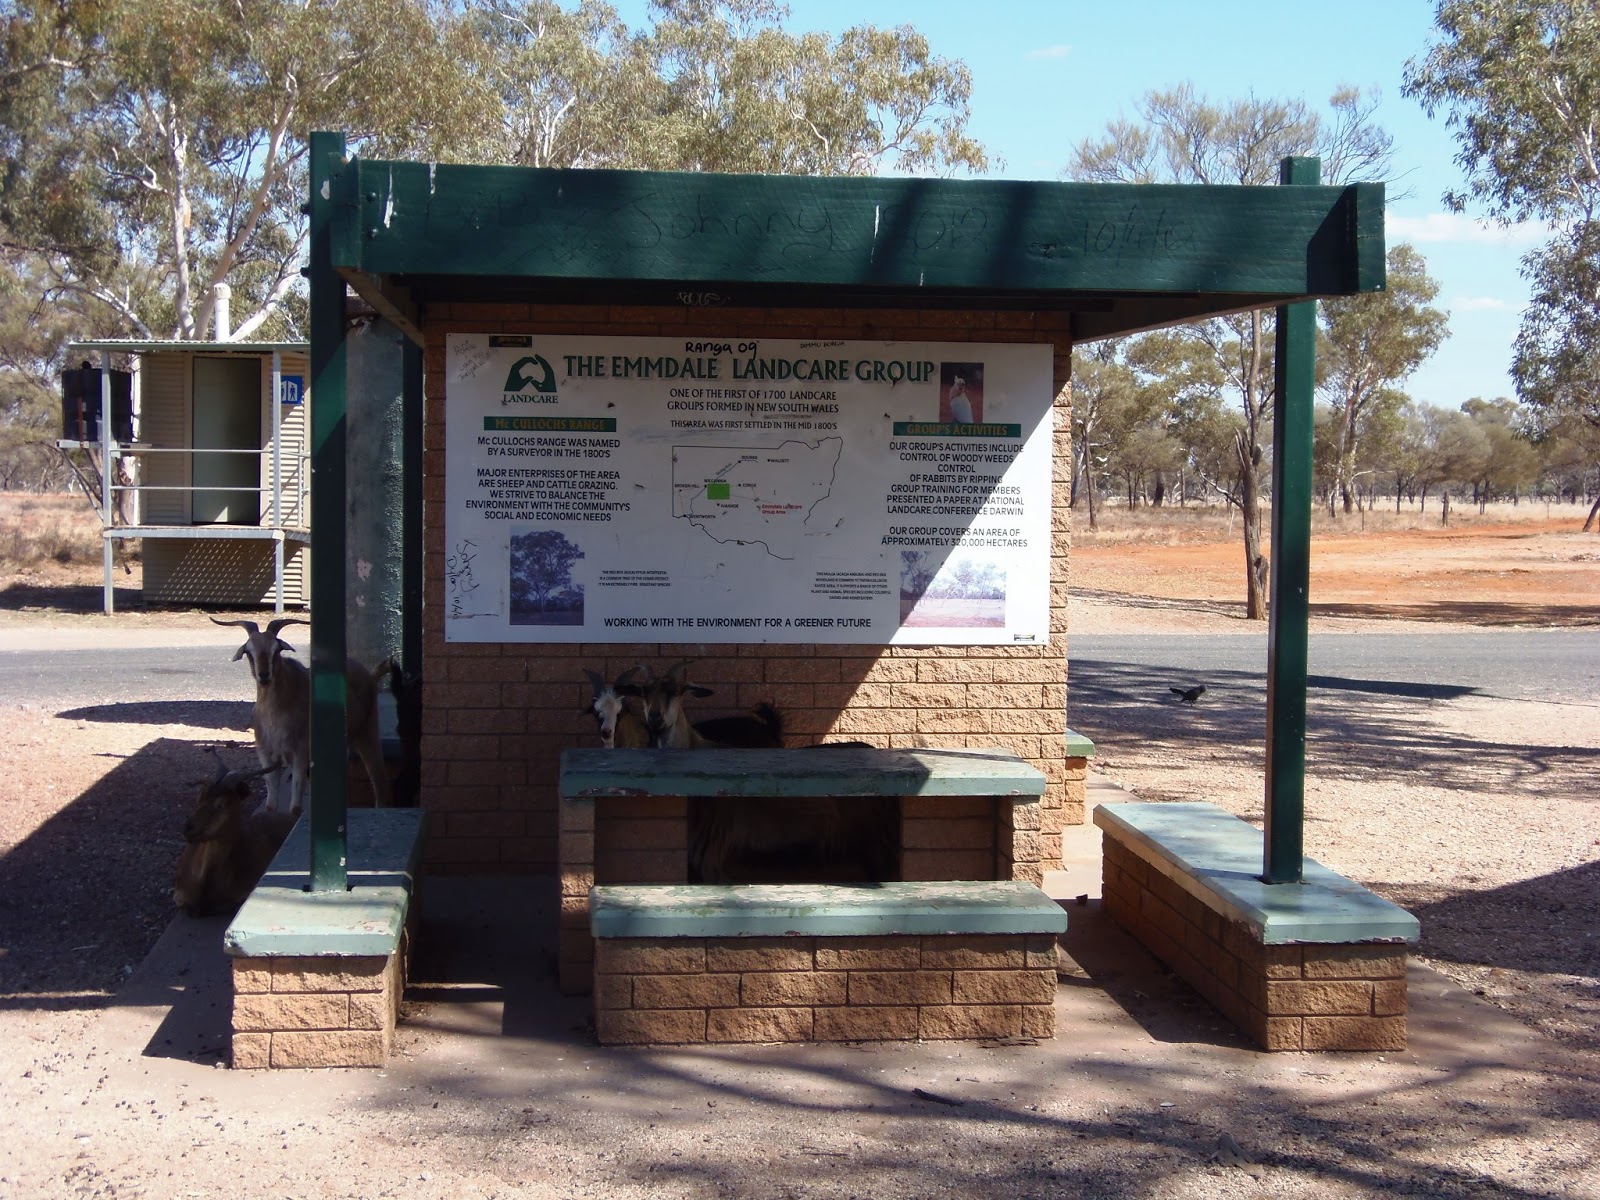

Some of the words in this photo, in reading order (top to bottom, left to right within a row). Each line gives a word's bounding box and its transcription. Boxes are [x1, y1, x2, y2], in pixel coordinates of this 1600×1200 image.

[563, 355, 605, 378] THE
[612, 356, 718, 380] EMMDALE
[732, 358, 850, 382] LANDCARE
[855, 360, 935, 382] GROUP
[503, 394, 558, 404] LANDCARE
[670, 388, 689, 399] ONE
[691, 389, 703, 399] OF
[705, 389, 722, 399] THE
[724, 389, 746, 400] FIRST
[748, 390, 760, 400] OF
[762, 390, 786, 400] 1700
[790, 390, 836, 401] LANDCARE
[667, 400, 704, 411] GROUPS
[706, 401, 742, 412] FORMED
[744, 402, 754, 412] IN
[756, 402, 776, 412] NEW
[778, 402, 808, 413] SOUTH
[810, 403, 838, 413] WALES
[514, 418, 566, 430] CULLOCHS
[571, 419, 606, 430] RANGE
[708, 420, 723, 429] WAS
[724, 421, 742, 429] FIRST
[744, 421, 772, 429] SETTLED
[773, 421, 782, 430] IN
[783, 421, 796, 430] THE
[797, 422, 811, 430] MID
[813, 422, 837, 430] 1800'S
[907, 424, 950, 435] GROUP'S
[951, 425, 1007, 436] ACTIVITIES
[491, 437, 534, 446] CULLOCHS
[536, 438, 566, 447] RANGE
[567, 438, 587, 447] WAS
[588, 438, 620, 448] NAMED
[890, 441, 907, 450] OUR
[908, 442, 943, 451] GROUP'S
[944, 442, 987, 452] ACTIVITIES
[988, 444, 1023, 453] INCLUDE
[488, 448, 498, 456] BY
[499, 448, 505, 456] A
[507, 448, 552, 457] SURVEYOR
[553, 449, 562, 457] IN
[564, 449, 580, 457] THE
[582, 449, 610, 458] 1800'S
[900, 452, 937, 462] CONTROL
[939, 453, 950, 462] OF
[952, 453, 982, 462] WOODY
[984, 454, 1013, 463] WEEDS
[938, 464, 975, 473] CONTROL
[477, 468, 506, 478] MAJOR
[508, 469, 564, 479] ENTERPRISES
[566, 470, 578, 479] OF
[579, 470, 595, 479] THE
[597, 470, 620, 480] AREA
[910, 474, 920, 483] OF
[922, 474, 956, 483] RABBITS
[957, 475, 967, 483] BY
[969, 475, 1002, 484] RIPPING
[478, 479, 495, 488] ARE
[496, 480, 524, 488] SHEEP
[526, 480, 544, 489] AND
[546, 480, 576, 489] CATTLE
[892, 484, 920, 493] GROUP
[921, 485, 960, 494] TRAINING
[961, 485, 978, 494] FOR
[979, 486, 1020, 494] MEMBERS
[490, 490, 503, 499] WE
[505, 490, 534, 499] STRIVE
[535, 491, 546, 499] TO
[548, 491, 587, 500] BALANCE
[588, 491, 604, 500] THE
[887, 495, 934, 504] PRESENTED
[935, 496, 941, 504] A
[943, 496, 970, 504] PAPER
[972, 496, 981, 505] AT
[982, 496, 1024, 506] NATIONAL
[466, 500, 528, 510] ENVIRONMENT
[530, 501, 552, 510] WITH
[554, 501, 570, 510] THE
[571, 502, 630, 512] COMMUNITY'S
[888, 506, 930, 514] LANDCARE
[932, 506, 988, 515] CONFERENCE
[989, 507, 1023, 516] DARWIN
[485, 511, 513, 520] SOCIAL
[515, 511, 534, 520] AND
[535, 512, 581, 521] ECONOMIC
[582, 512, 611, 522] NEEDS
[890, 527, 907, 535] OUR
[908, 527, 937, 536] GROUP
[938, 527, 970, 536] COVERS
[972, 528, 984, 536] AN
[985, 528, 1007, 537] AREA
[1008, 528, 1020, 537] OF
[882, 537, 949, 546] APPROXIMATELY
[986, 538, 1027, 547] HECTARES
[605, 617, 648, 627] WORKING
[650, 618, 674, 627] WITH
[676, 618, 693, 627] THE
[697, 618, 762, 627] ENVIRONMENT
[764, 618, 782, 627] FOR
[783, 618, 791, 627] A
[792, 618, 834, 627] GREENER
[836, 618, 871, 627] FUTURE
